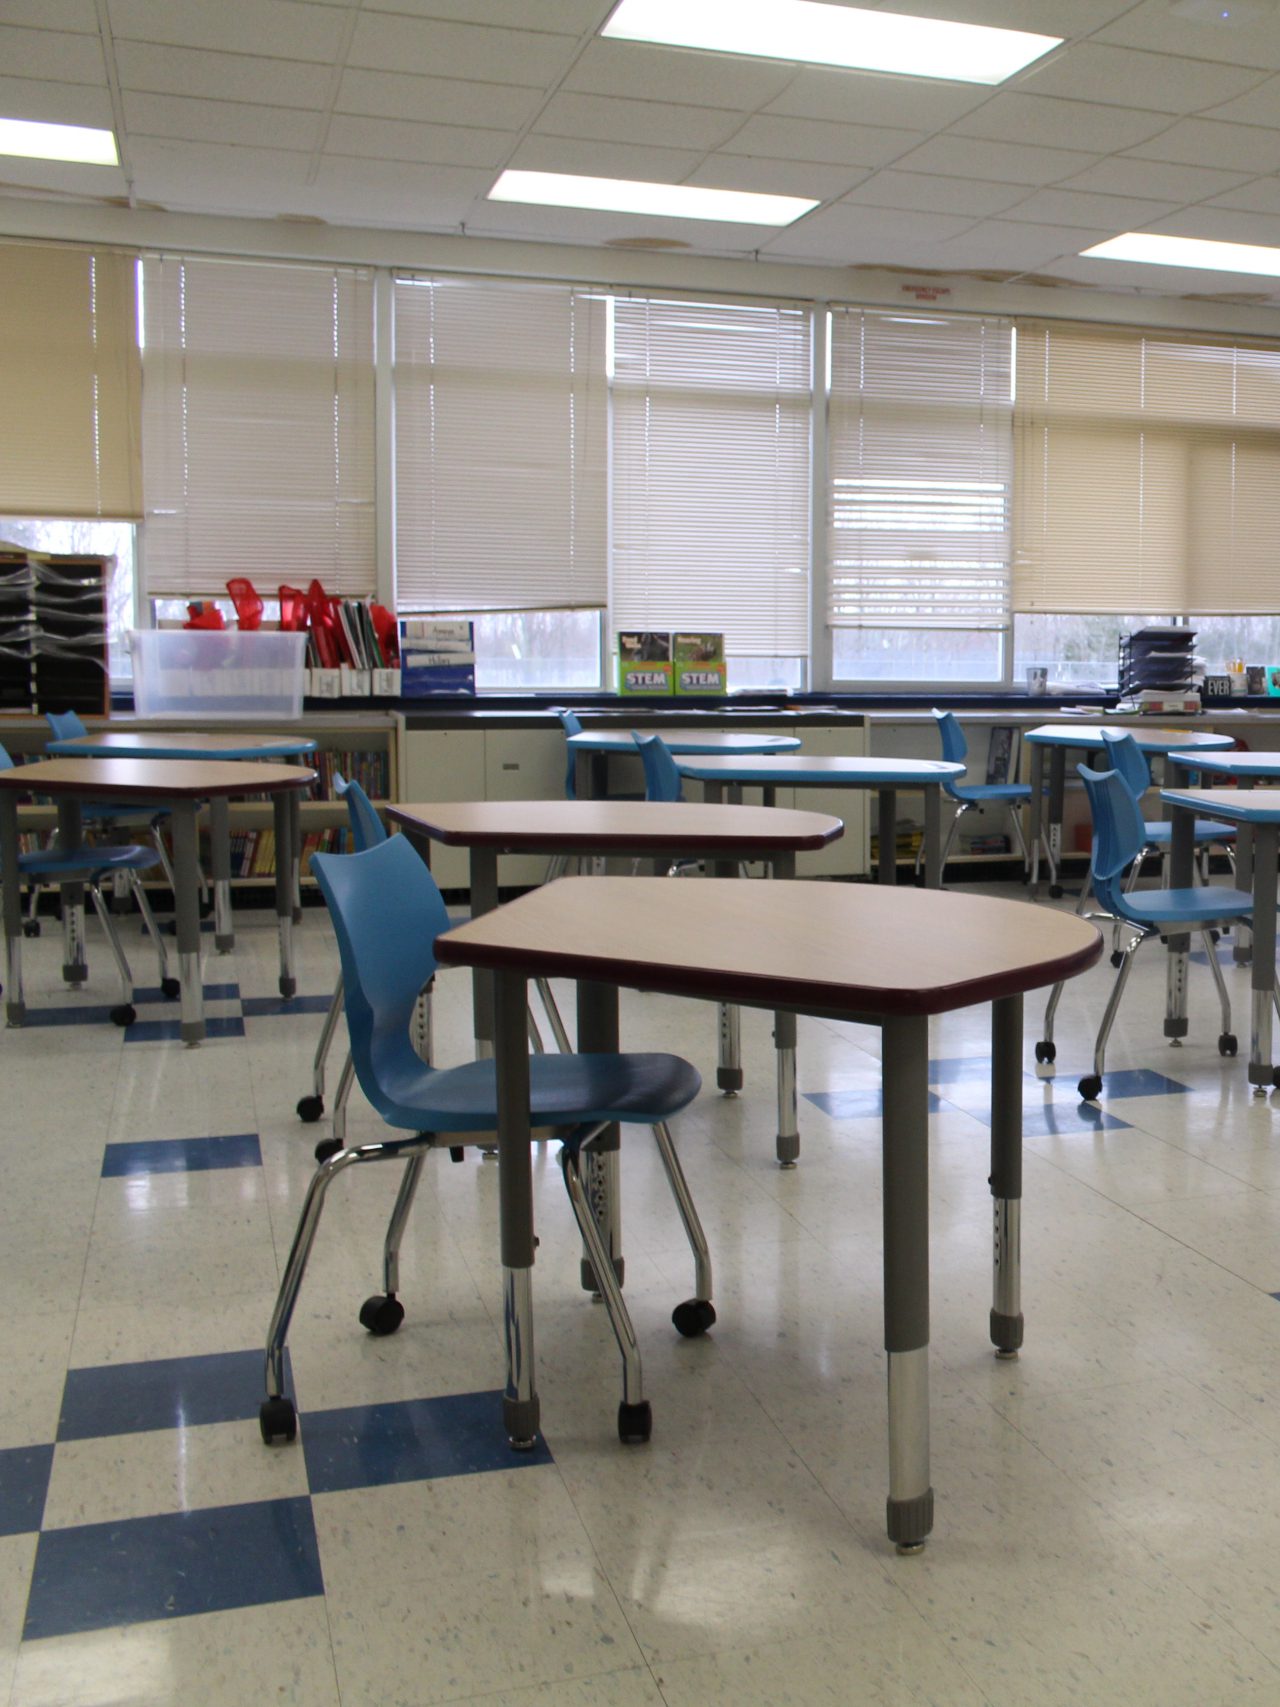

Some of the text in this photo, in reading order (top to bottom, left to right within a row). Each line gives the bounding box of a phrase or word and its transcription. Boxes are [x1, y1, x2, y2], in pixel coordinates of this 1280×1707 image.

[627, 673, 666, 684] STEM
[681, 672, 719, 684] STEM
[1208, 680, 1230, 695] EVER
